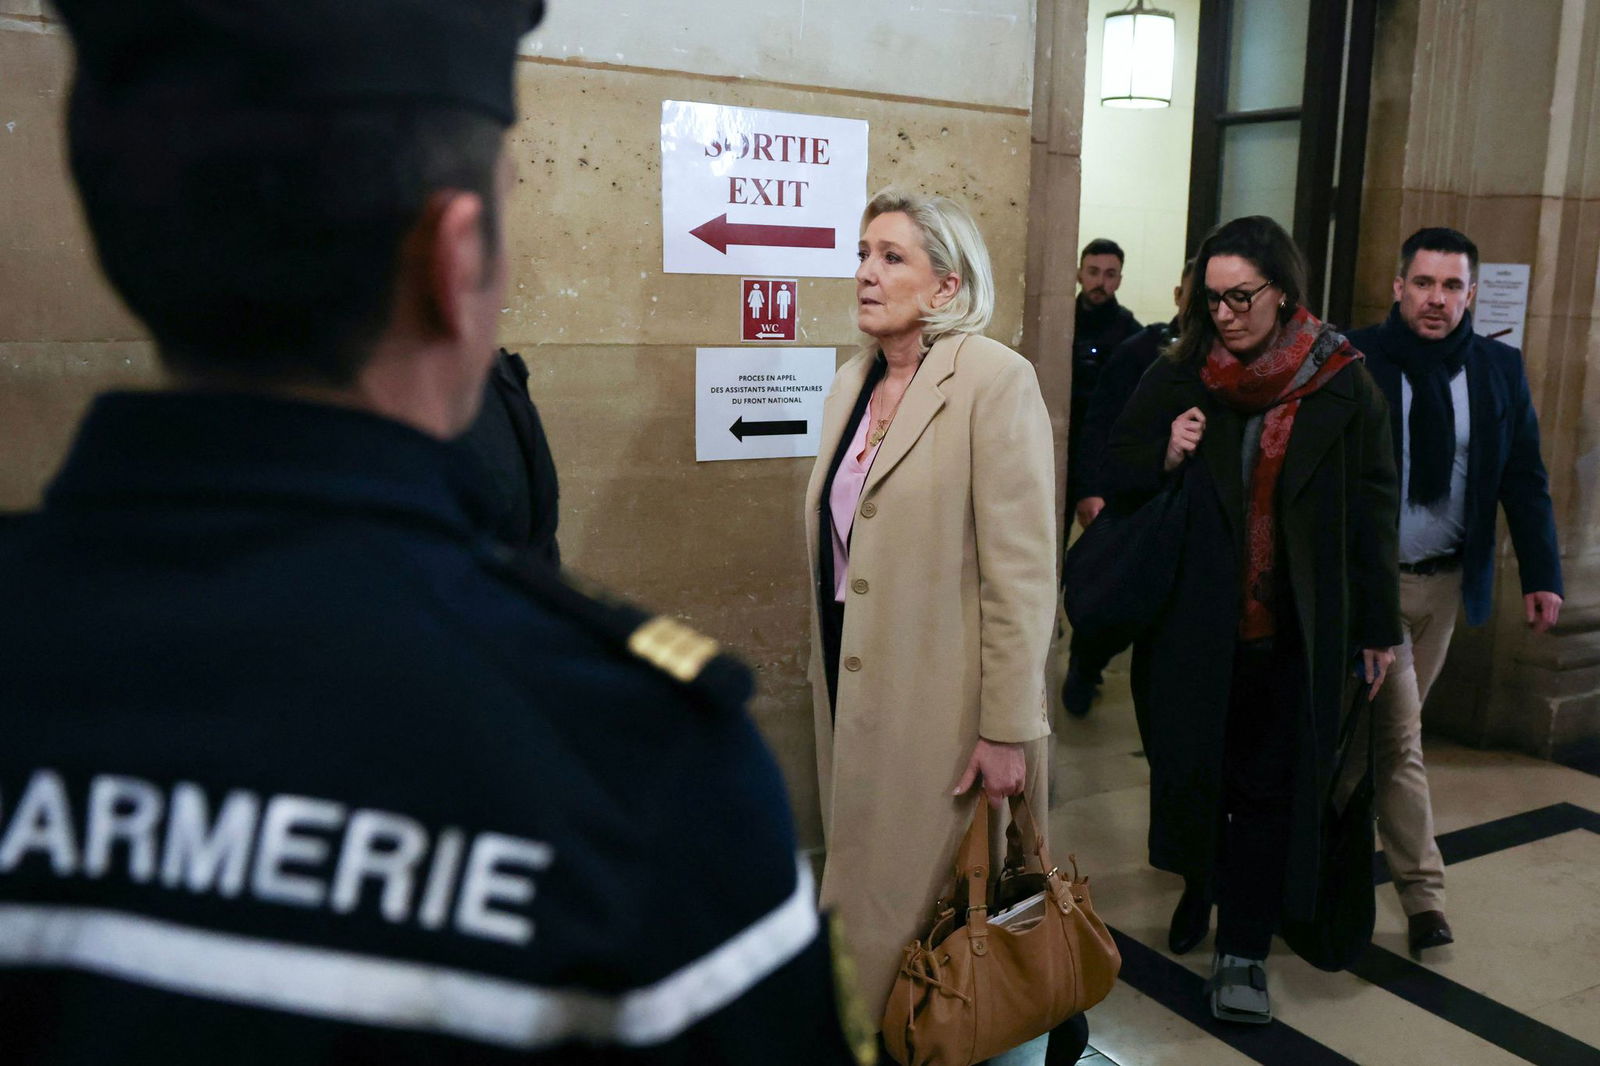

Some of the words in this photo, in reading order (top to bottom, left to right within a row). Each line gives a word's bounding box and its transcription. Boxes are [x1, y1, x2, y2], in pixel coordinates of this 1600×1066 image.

[727, 176, 810, 208] EXIT
[760, 323, 780, 333] WC
[710, 386, 724, 394] DES
[725, 385, 766, 394] ASSISTANTS
[766, 385, 823, 393] PARLEMENTAIRES
[743, 397, 766, 405] FRONT
[0, 768, 556, 946] ARMERIE
